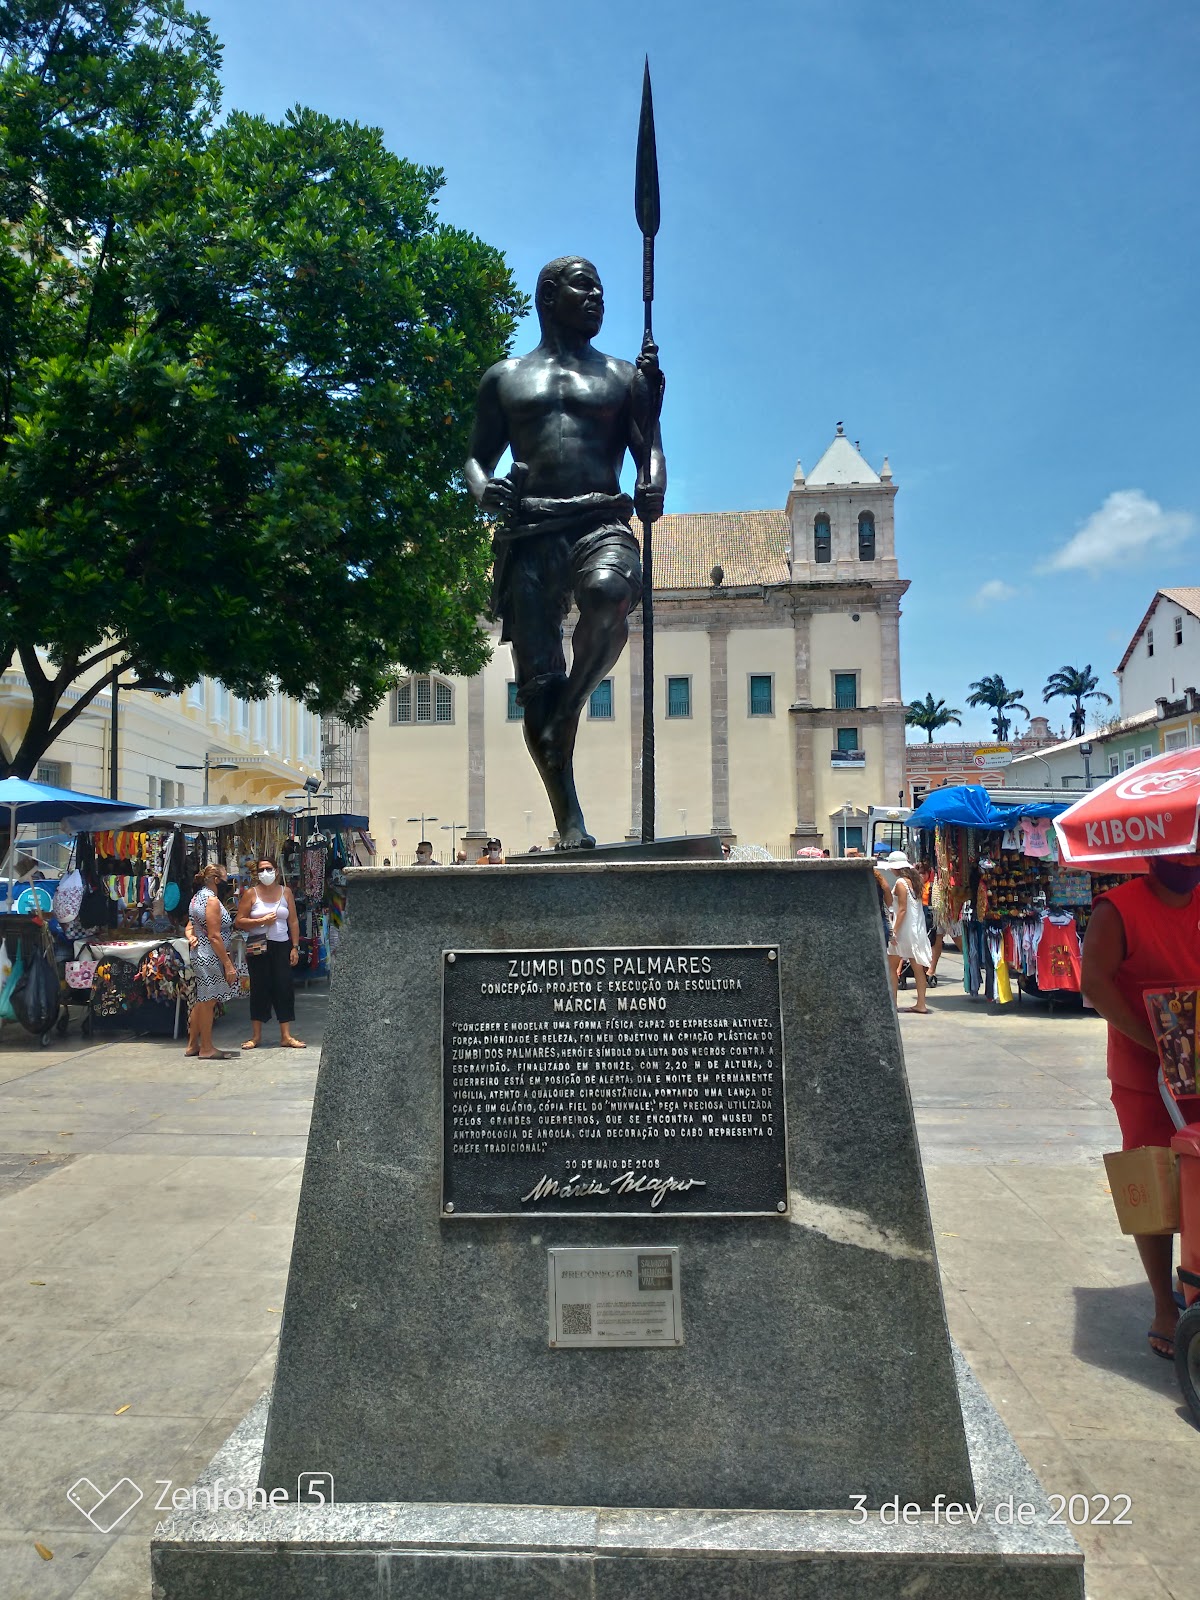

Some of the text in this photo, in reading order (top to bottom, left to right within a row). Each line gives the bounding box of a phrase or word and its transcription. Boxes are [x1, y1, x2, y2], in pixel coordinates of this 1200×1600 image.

[1085, 814, 1165, 847] KIBON
[508, 956, 712, 977] ZUMBI DOS PALMARES
[480, 977, 742, 996] CONCEPÇÃO, PROJETO E EXECUÇÃO DA ESCULTURA
[553, 995, 667, 1012] MÁRCIA MAGNO
[504, 1022, 508, 1031] E
[511, 1022, 549, 1031] MODELAR
[553, 1021, 570, 1030] UMA
[574, 1021, 602, 1030] FORMA
[606, 1018, 634, 1029] FÍSICA
[638, 1020, 665, 1029] CAPAZ
[670, 1020, 680, 1028] DE
[683, 1019, 728, 1028] EXPRESSAR
[733, 1018, 773, 1028] ALTIVEZ,
[484, 1035, 530, 1044] DIGNIDADE
[534, 1035, 538, 1043] E
[542, 1034, 577, 1044] BELEZA,
[580, 1034, 593, 1043] FOI
[596, 1034, 613, 1042] MEU
[618, 1033, 659, 1042] OBJETIVO
[663, 1033, 674, 1041] NA
[678, 1031, 713, 1043] CRIAÇÃO
[718, 1030, 758, 1041] PLÁSTICA
[762, 1032, 773, 1041] DO
[452, 1045, 774, 1060] ZUMBI DOS PALMARES, HERÓI E SÍMBOLO DA LUTA DOS NEGROS CONTRA A
[452, 1060, 773, 1073] ESCRAVIDÃO. FINALIZADO EM BRONZE, COM 2,20 M DE ALTURA, O
[453, 1077, 499, 1086] GUERREIRO
[504, 1074, 524, 1085] ESTÁ
[529, 1076, 541, 1085] EM
[545, 1073, 581, 1086] POSIÇÃO
[585, 1076, 596, 1084] DE
[637, 1075, 651, 1083] DIA
[656, 1075, 661, 1083] E
[666, 1074, 692, 1083] NOITE
[697, 1074, 709, 1082] EM
[715, 1073, 773, 1082] PERMANENTE
[453, 1090, 487, 1100] VIGILIA,
[490, 1090, 520, 1099] ATENTO
[523, 1090, 528, 1098] A
[531, 1089, 575, 1098] QUALQUER
[654, 1088, 699, 1097] PORTANDO
[704, 1088, 723, 1096] UMA
[728, 1088, 756, 1098] LANÇA
[762, 1088, 772, 1096] DE
[452, 1103, 473, 1115] CAÇA
[477, 1104, 481, 1112] E
[485, 1103, 497, 1112] UM
[500, 1101, 537, 1113] GLÁDIO,
[538, 1100, 564, 1111] CÓPIA
[569, 1102, 587, 1110] FIEL
[591, 1102, 603, 1110] DO
[658, 1101, 679, 1112] PEÇA
[683, 1101, 724, 1110] PRECIOSA
[727, 1100, 772, 1109] UTILIZADA
[453, 1113, 773, 1125] PELOS GRANDES GUERREIROS, QUE SE ENCONTRA NO MUSEU DE
[453, 1129, 517, 1139] ANTROPOLOGIA
[522, 1129, 533, 1138] DE
[579, 1129, 601, 1138] CUJA
[606, 1126, 659, 1140] DECORAÇÃO
[664, 1128, 676, 1137] DO
[680, 1128, 703, 1136] CABO
[708, 1127, 763, 1136] REPRESENTA
[767, 1127, 773, 1136] O
[453, 1143, 480, 1153] CHEFE
[565, 1159, 660, 1169] 30 DE MAIO DE 2008
